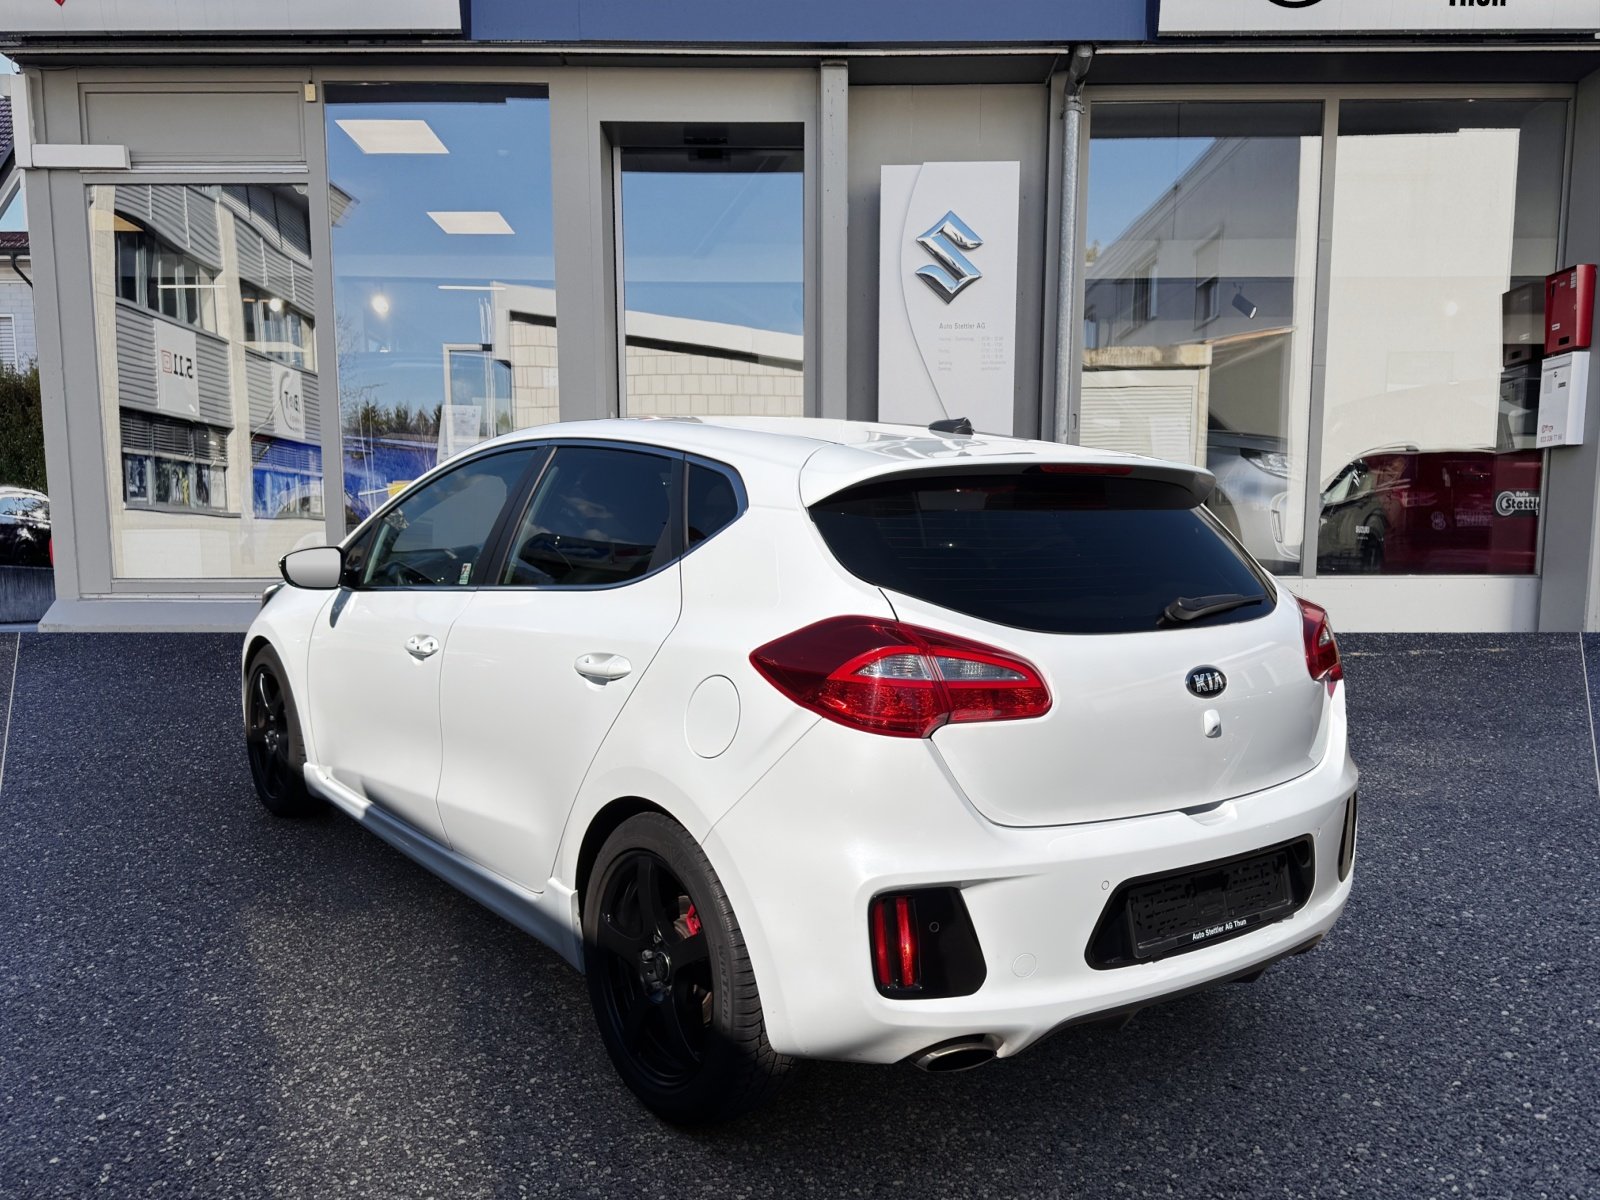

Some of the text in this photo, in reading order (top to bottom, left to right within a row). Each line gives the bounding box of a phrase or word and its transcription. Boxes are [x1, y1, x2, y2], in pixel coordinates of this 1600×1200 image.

[1193, 672, 1223, 692] KIA
[1193, 920, 1246, 940] Auto Stettler AG Thun
